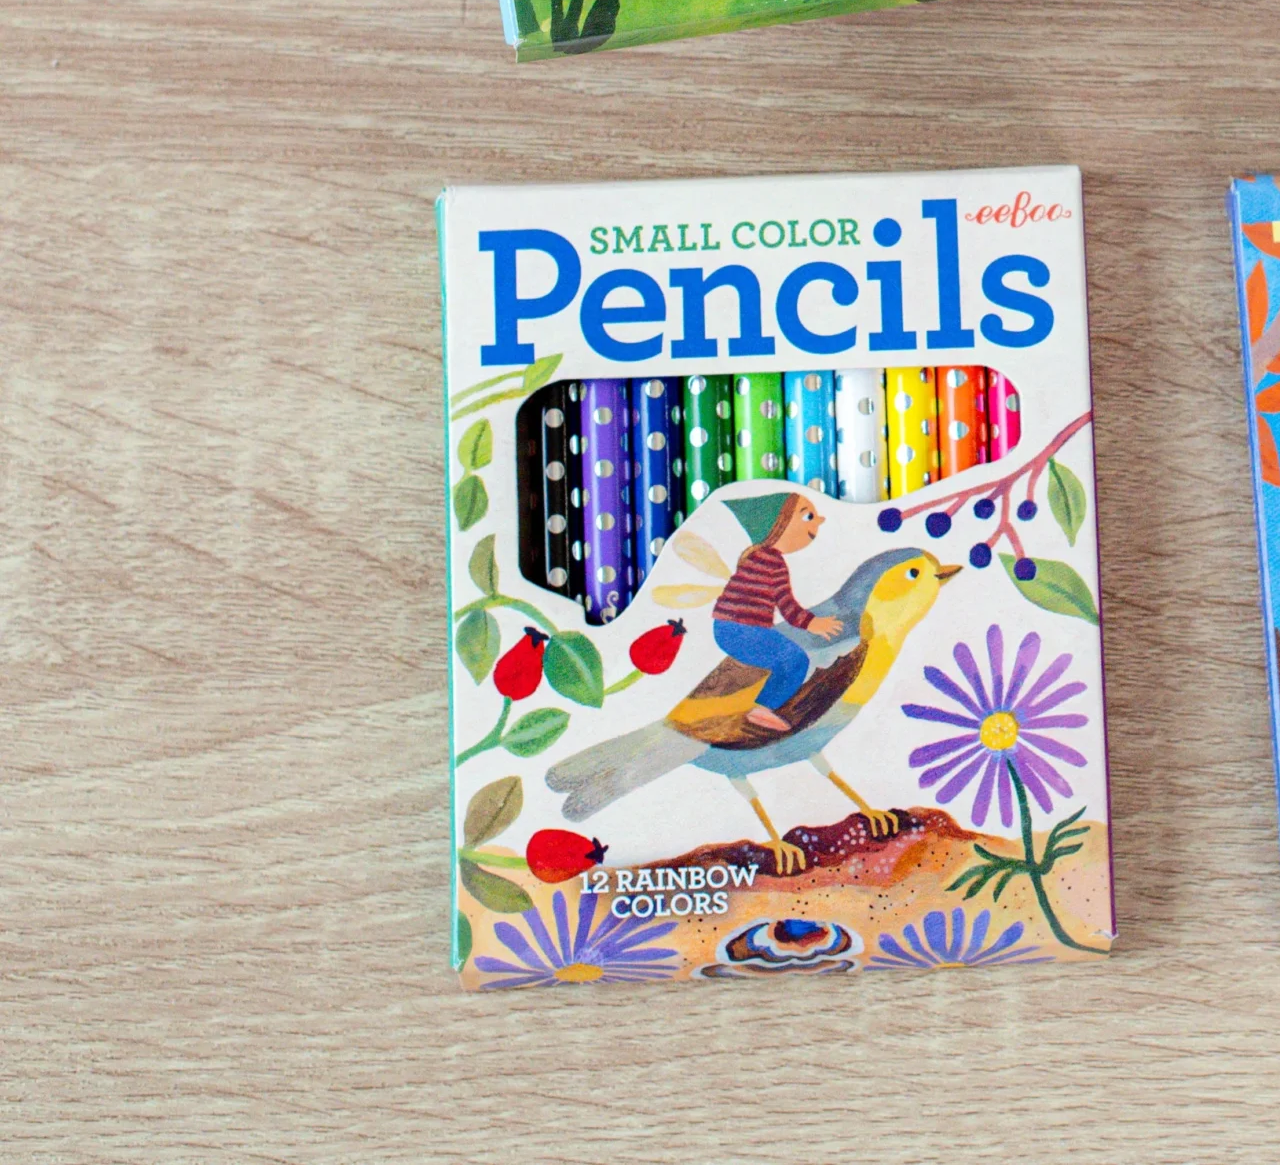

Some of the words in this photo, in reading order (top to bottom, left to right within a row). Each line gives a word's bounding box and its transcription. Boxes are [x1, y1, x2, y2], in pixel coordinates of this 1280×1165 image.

[964, 190, 1073, 229] eeboo
[588, 223, 721, 256] SMALL
[731, 218, 861, 250] COLOR
[478, 198, 1055, 367] Pencils
[579, 871, 610, 895] 12
[615, 864, 760, 893] RAINBOW
[611, 891, 729, 919] COLORS
